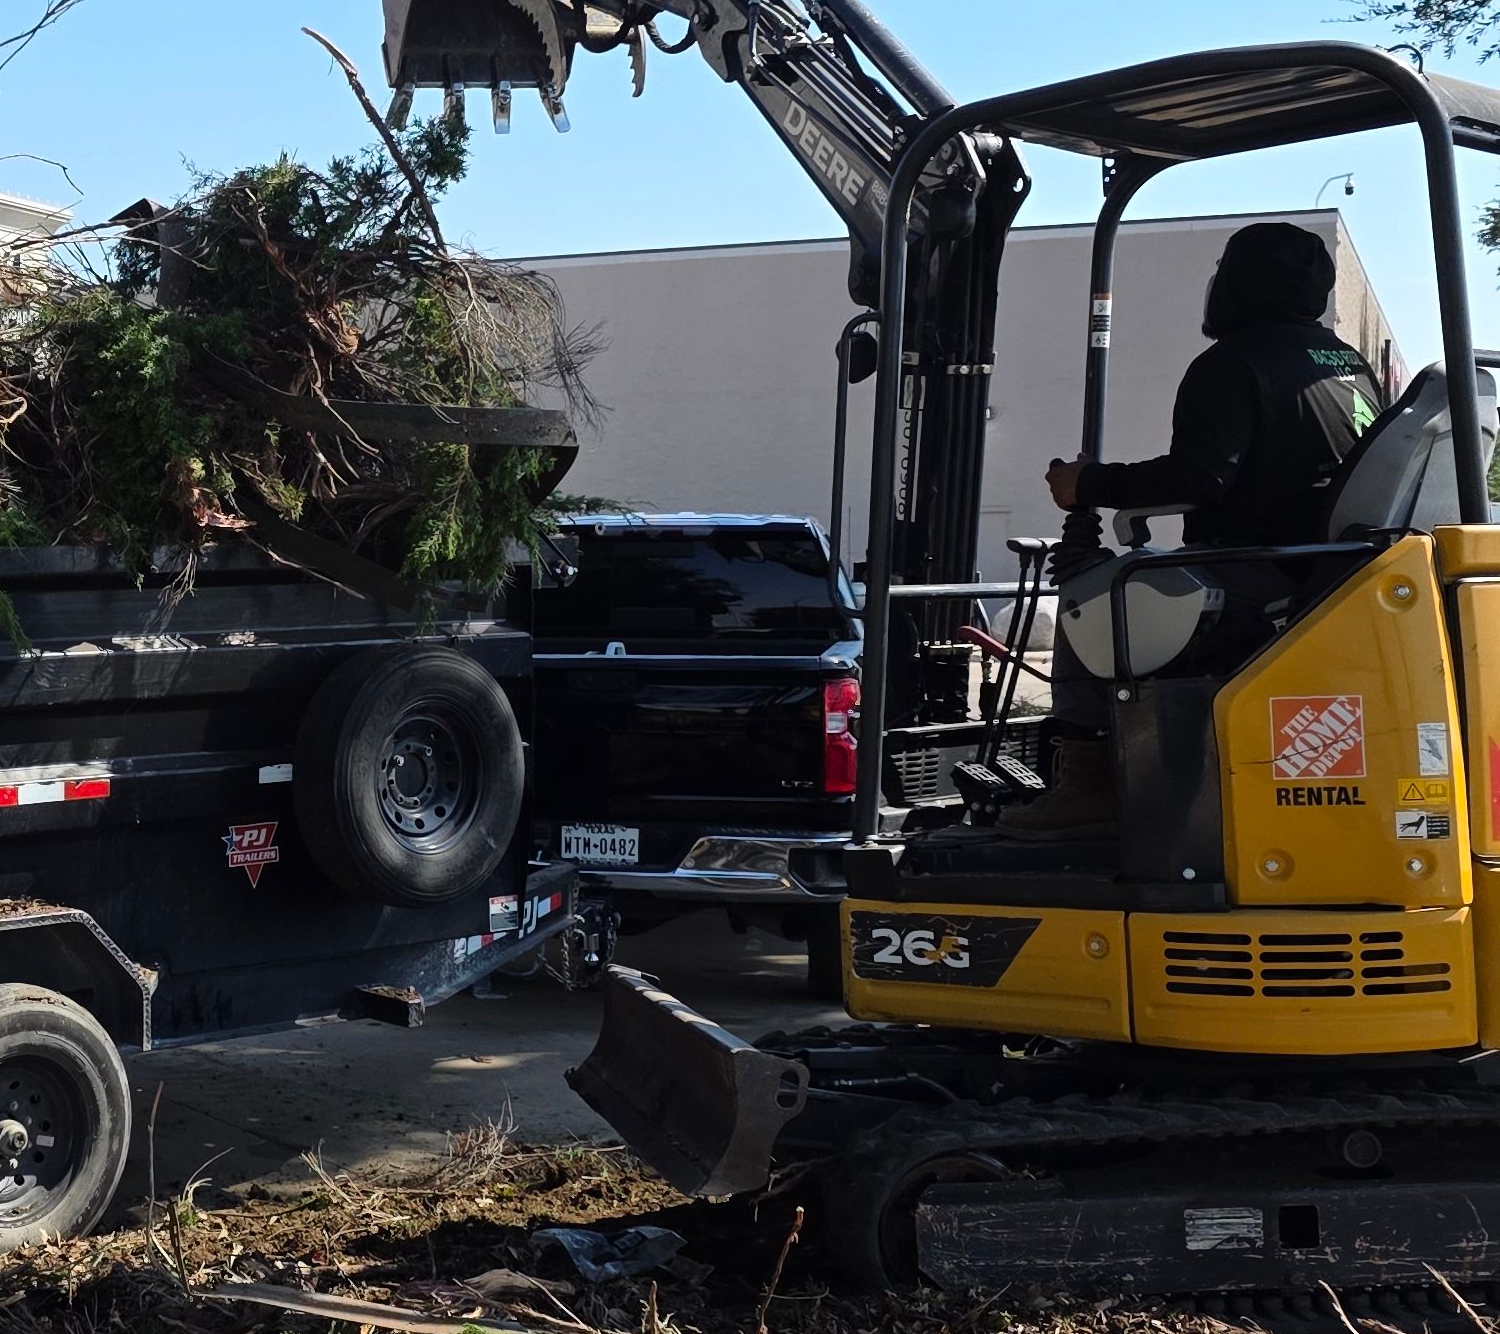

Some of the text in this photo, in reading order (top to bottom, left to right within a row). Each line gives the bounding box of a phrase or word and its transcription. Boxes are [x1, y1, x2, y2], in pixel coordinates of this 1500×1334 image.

[783, 100, 865, 206] DEERE
[1274, 696, 1362, 778] HOME
[1280, 704, 1318, 738] THE
[1309, 726, 1362, 778] DEPOT
[1276, 787, 1366, 806] RENTAL
[232, 850, 276, 864] TRAILERS
[242, 828, 267, 847] PJ
[518, 895, 539, 939] PJ
[871, 928, 970, 968] 26G
